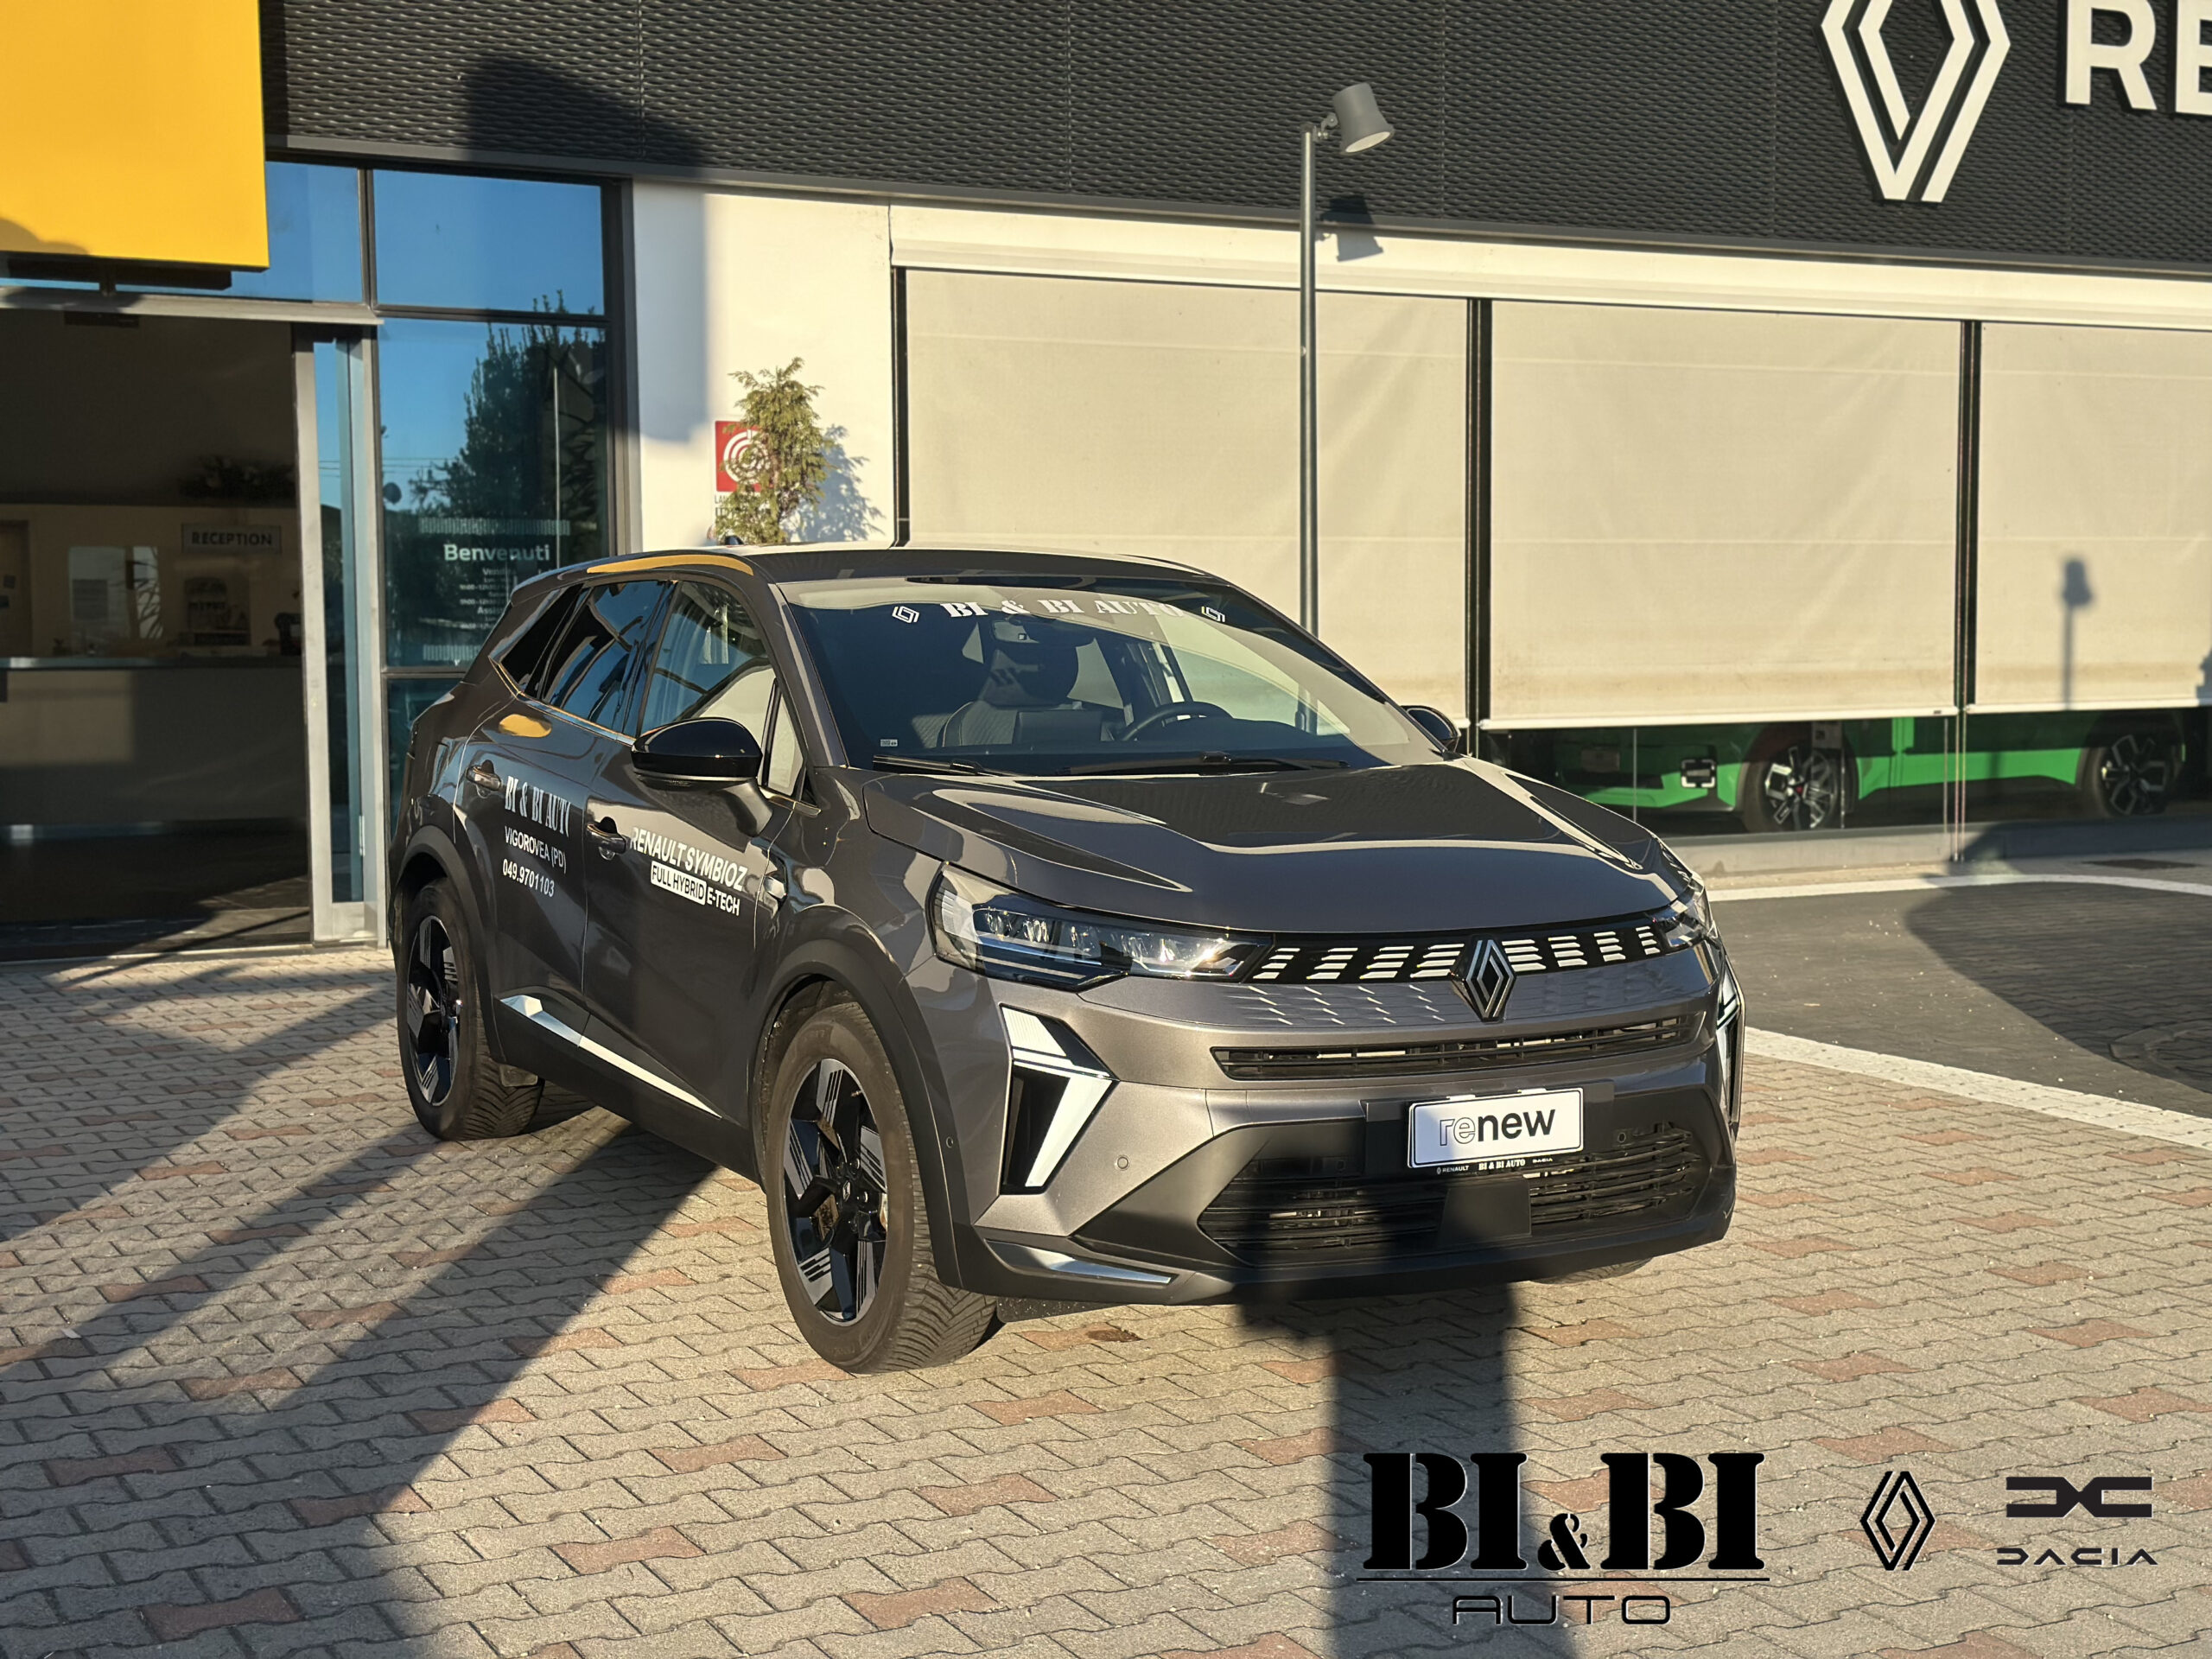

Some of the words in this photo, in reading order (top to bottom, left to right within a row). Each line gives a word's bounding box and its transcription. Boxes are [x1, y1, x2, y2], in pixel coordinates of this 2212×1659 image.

[192, 531, 272, 546] RECEPTION
[443, 544, 550, 562] Benvenuti
[940, 601, 988, 618] BI
[1001, 600, 1030, 614] &
[1037, 599, 1085, 613] BI
[1093, 600, 1185, 617] AUTO
[505, 775, 518, 813] BI
[519, 781, 528, 818] &
[531, 786, 544, 824] BI
[505, 825, 550, 861] VIGOROVEA
[551, 845, 567, 874] (PD)
[629, 827, 688, 868] RENAULT
[684, 847, 748, 892] SYMBIOZ
[502, 858, 555, 898] 049.9701103
[652, 865, 671, 887] FULL
[672, 872, 705, 900] HYBRID
[706, 887, 741, 916] E-TECH
[1440, 1109, 1555, 1147] renew
[1478, 1162, 1488, 1171] BI
[1488, 1161, 1495, 1170] &
[1496, 1160, 1504, 1170] BI
[1505, 1159, 1526, 1168] AUTO
